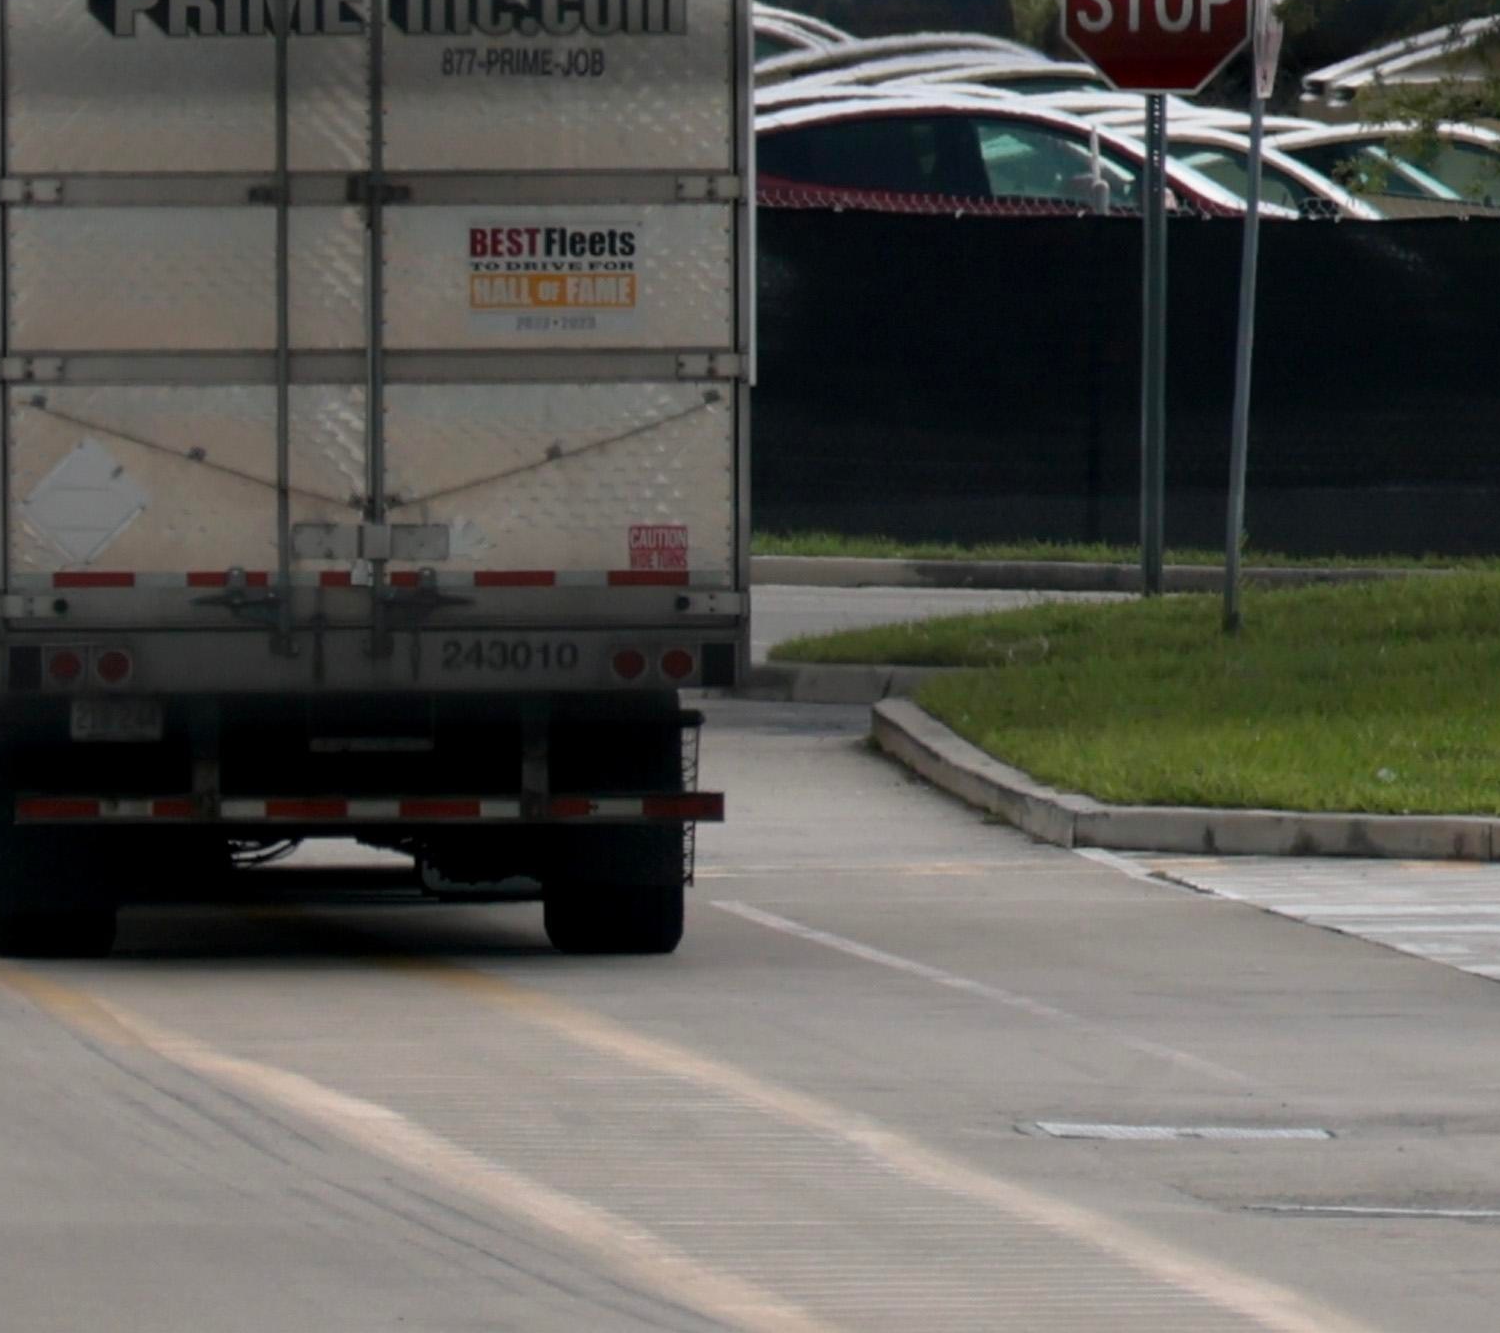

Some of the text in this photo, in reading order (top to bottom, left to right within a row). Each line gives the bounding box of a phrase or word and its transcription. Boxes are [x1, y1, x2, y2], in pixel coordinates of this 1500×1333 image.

[441, 47, 605, 78] 877-PRIME-JOB
[471, 260, 634, 271] TO DRIVE FOR
[473, 276, 532, 306] HALL
[566, 276, 632, 306] FAME
[631, 527, 687, 550] CAUTION
